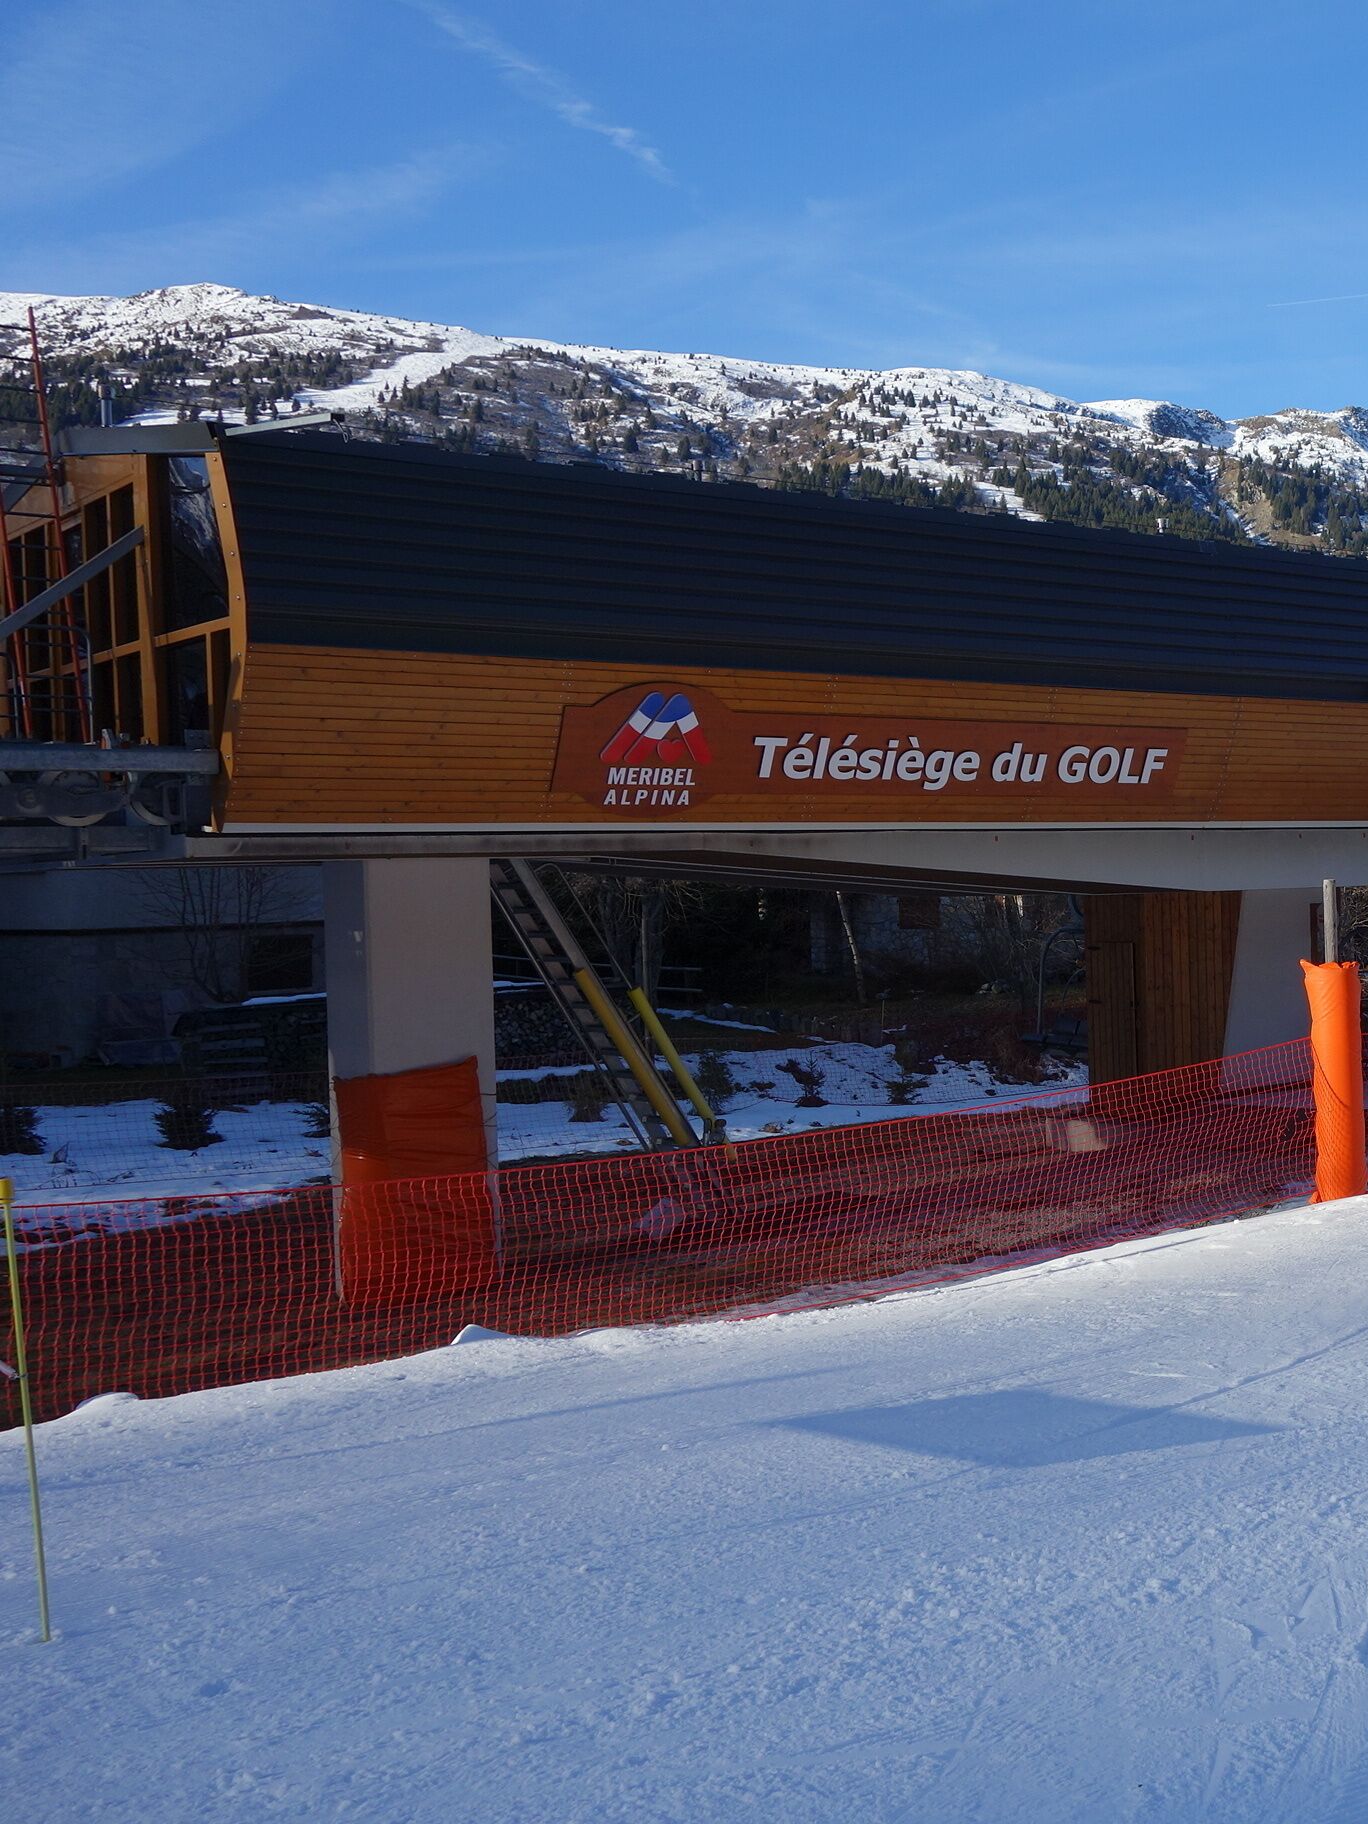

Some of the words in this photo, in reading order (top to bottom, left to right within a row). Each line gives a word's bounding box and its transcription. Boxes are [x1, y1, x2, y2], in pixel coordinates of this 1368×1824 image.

[754, 733, 981, 791] Télésiège
[991, 742, 1048, 783] du
[1058, 745, 1168, 784] GOLF
[607, 767, 695, 786] MERIBEL
[603, 789, 689, 805] ALPINA
